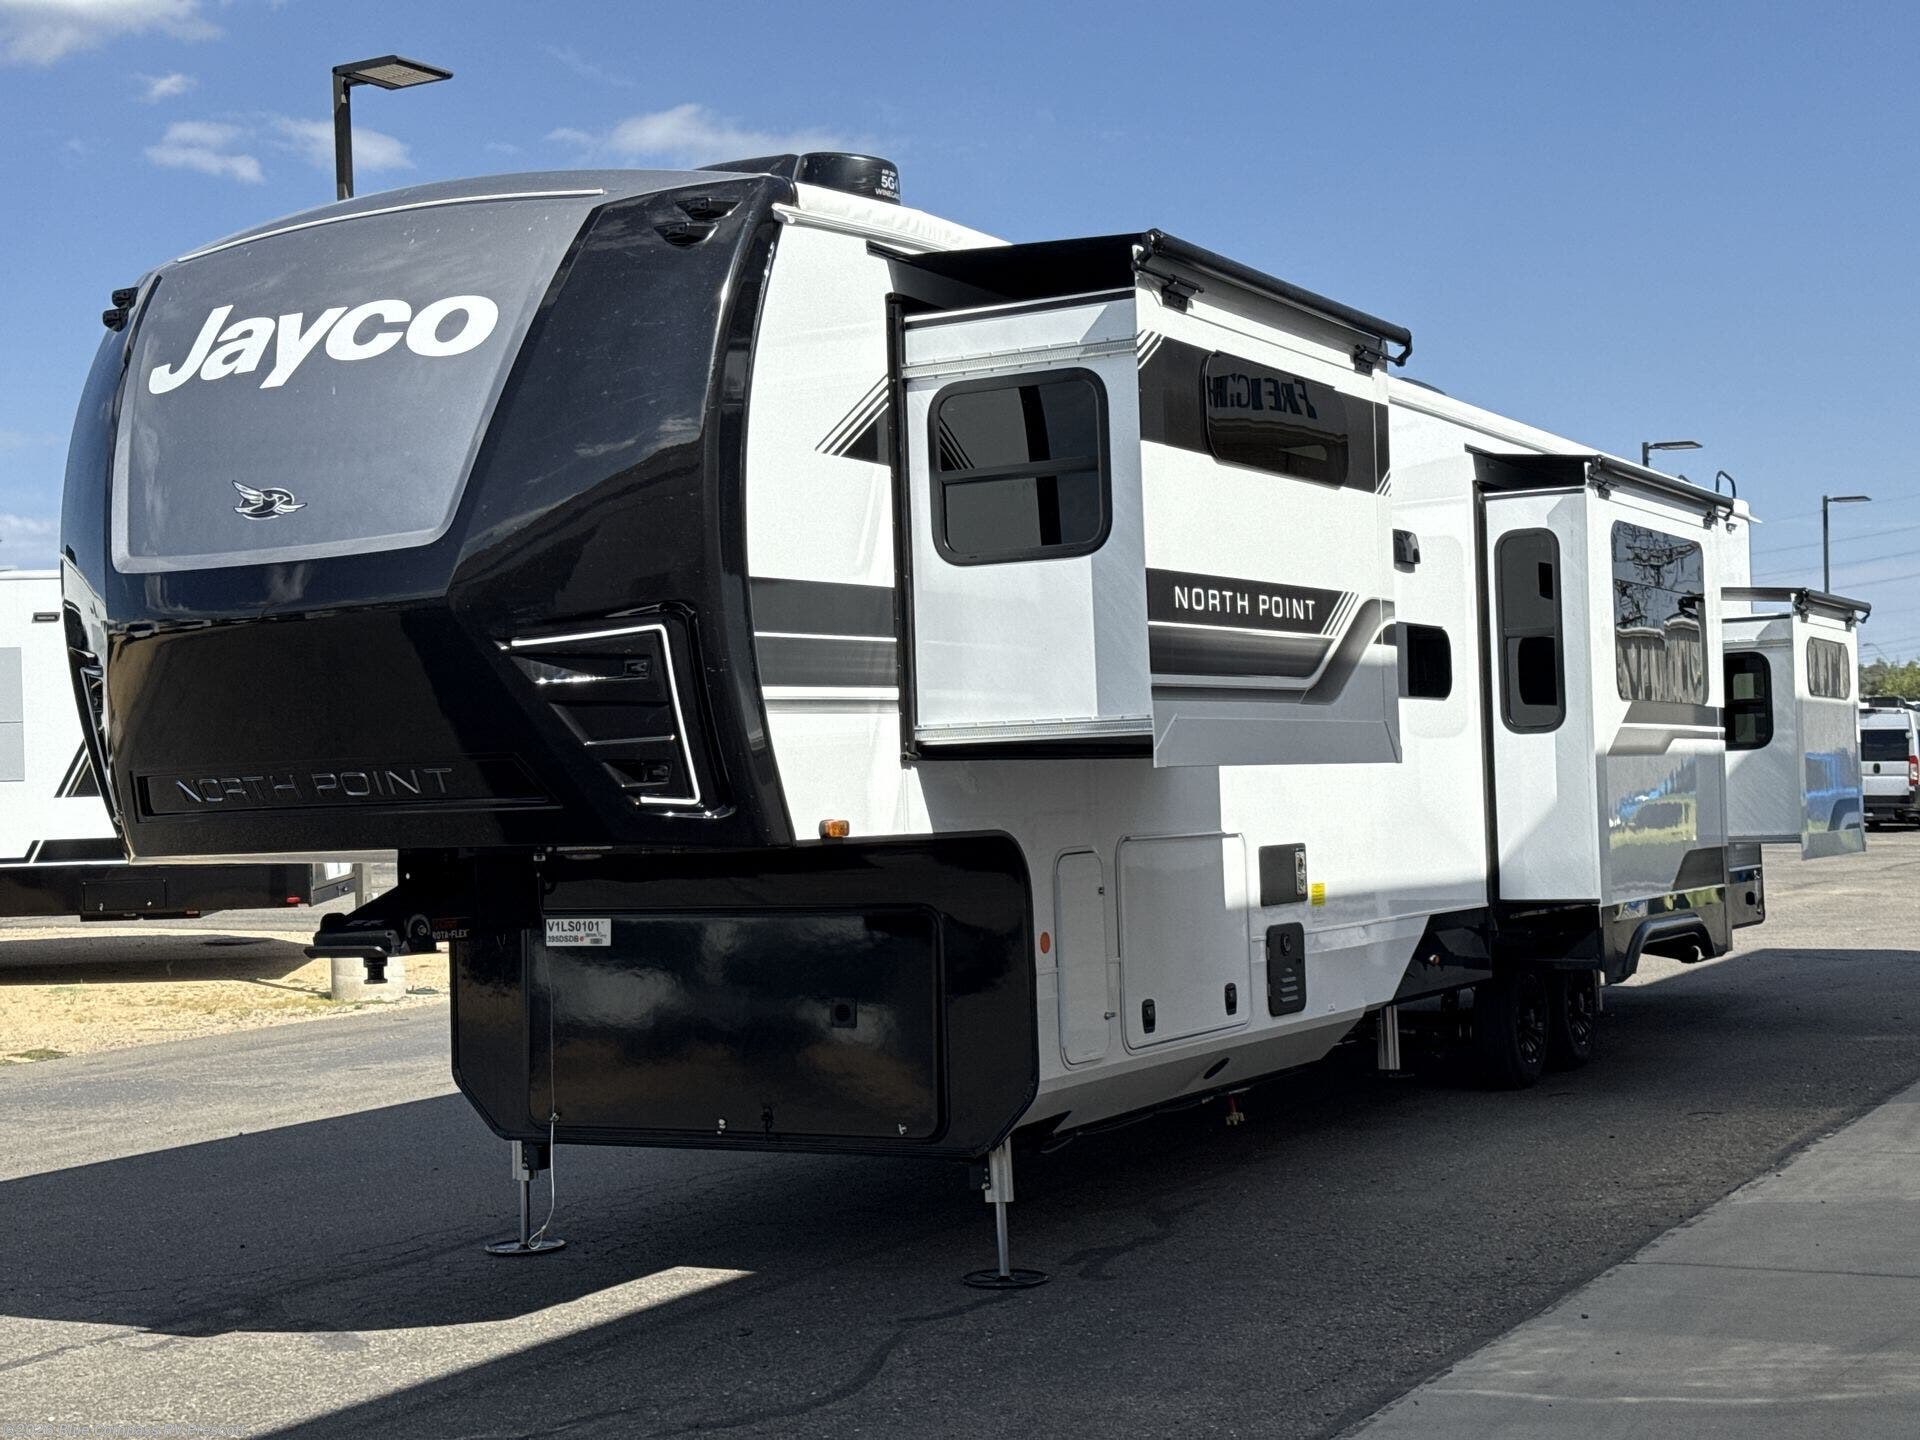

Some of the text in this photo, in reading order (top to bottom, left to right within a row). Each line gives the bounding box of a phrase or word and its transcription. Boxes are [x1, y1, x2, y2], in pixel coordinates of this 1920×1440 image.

[881, 175, 895, 190] 5G
[148, 294, 500, 395] Jayco
[1173, 585, 1316, 621] NORTH POINT
[175, 767, 453, 803] NORTH POINT
[547, 920, 600, 932] V1LS0101
